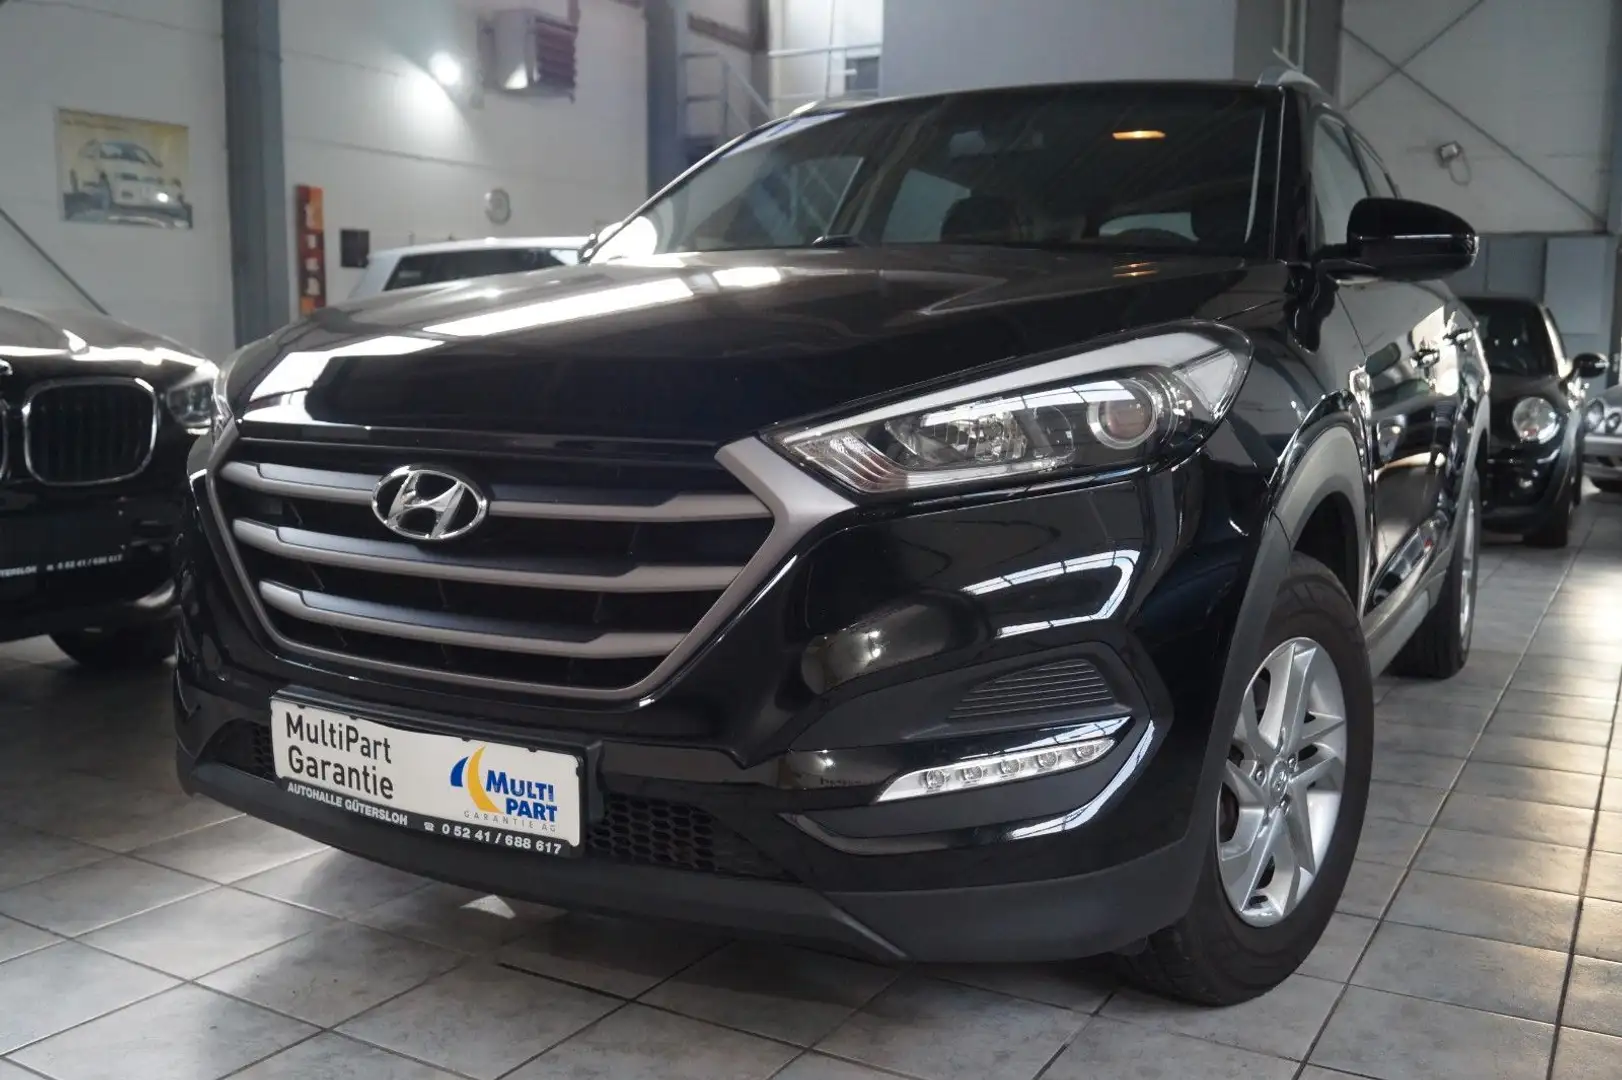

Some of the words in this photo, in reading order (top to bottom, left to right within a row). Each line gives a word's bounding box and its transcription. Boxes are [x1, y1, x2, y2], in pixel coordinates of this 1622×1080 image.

[286, 711, 391, 764] MultiPart
[288, 744, 394, 799] Garantie
[485, 769, 554, 802] MULTI
[287, 782, 342, 808] AUTOHALLE
[344, 798, 408, 826] GÜTERSLOH
[505, 797, 558, 822] PART
[463, 810, 534, 829] GARANTIE
[541, 823, 556, 833] AG
[441, 823, 450, 835] 0
[453, 826, 471, 839] 52
[474, 829, 490, 842] 41
[504, 834, 531, 849] 688
[535, 840, 562, 855] 617
